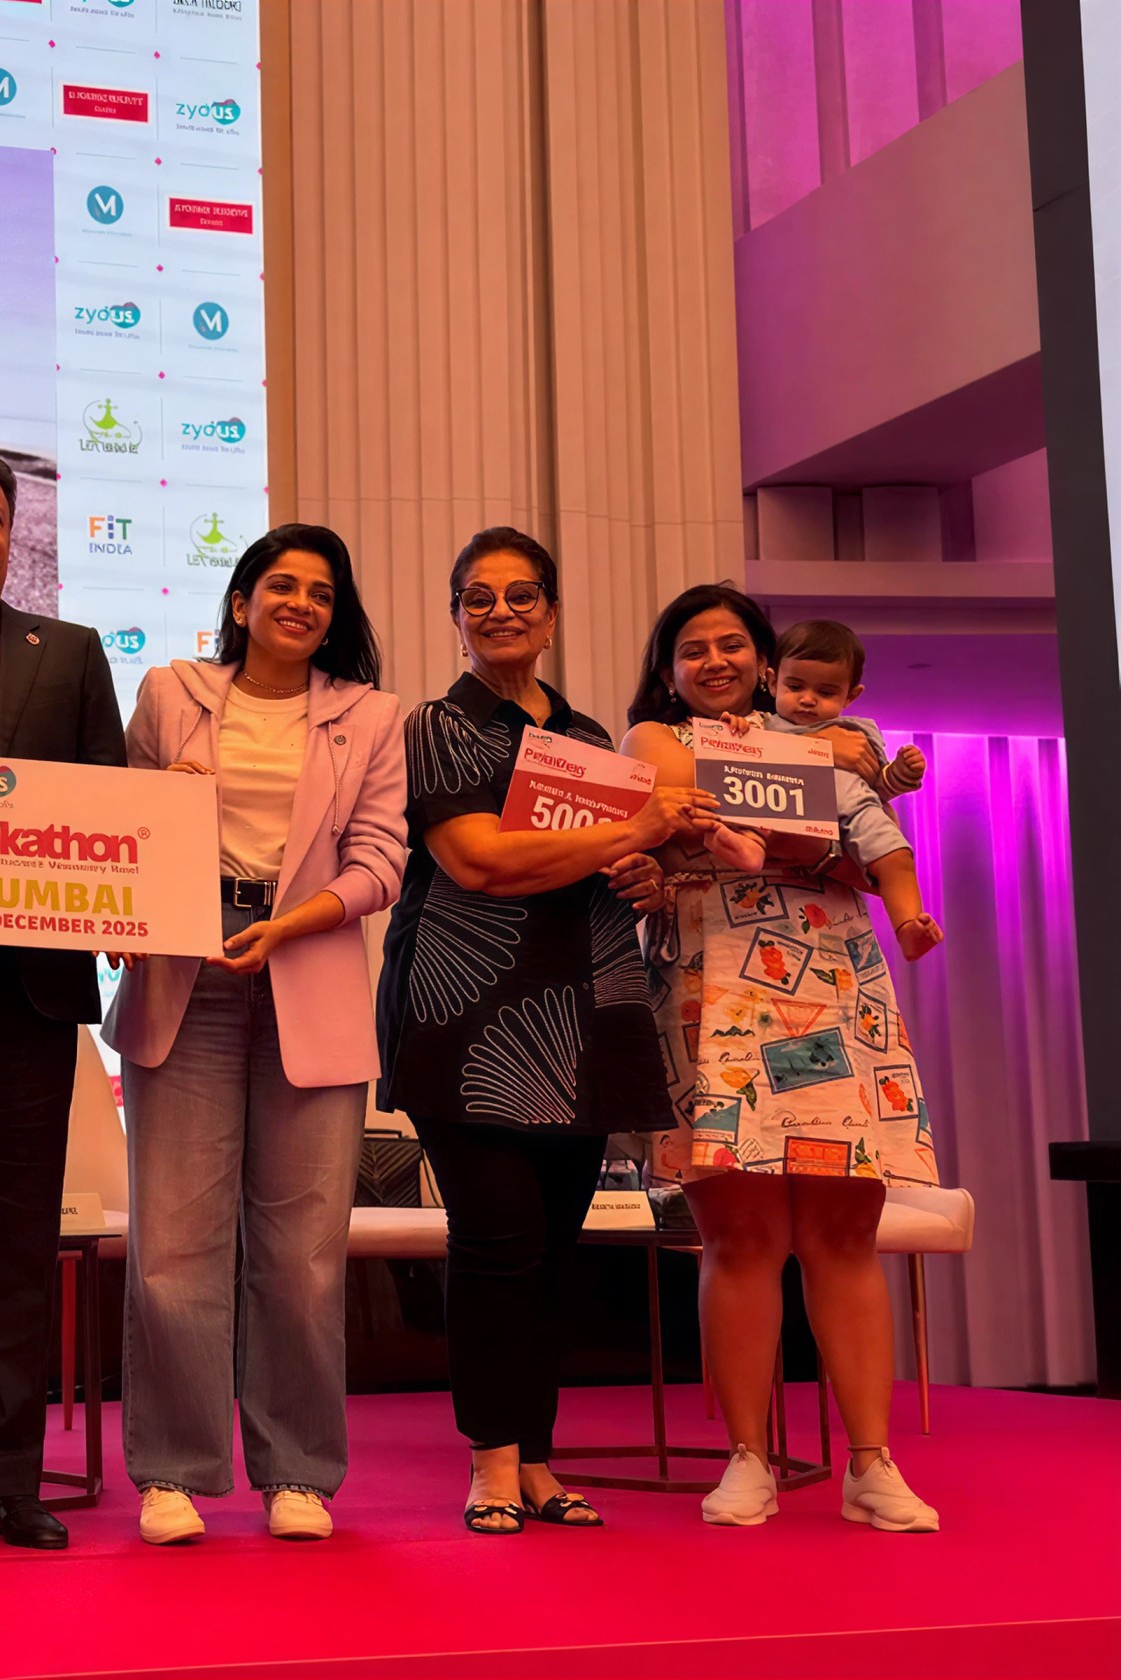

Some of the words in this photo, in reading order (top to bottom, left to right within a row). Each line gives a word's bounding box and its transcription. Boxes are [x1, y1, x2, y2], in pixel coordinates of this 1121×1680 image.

[530, 796, 613, 831] 500
[723, 776, 805, 817] 3001
[102, 920, 149, 937] 2025
